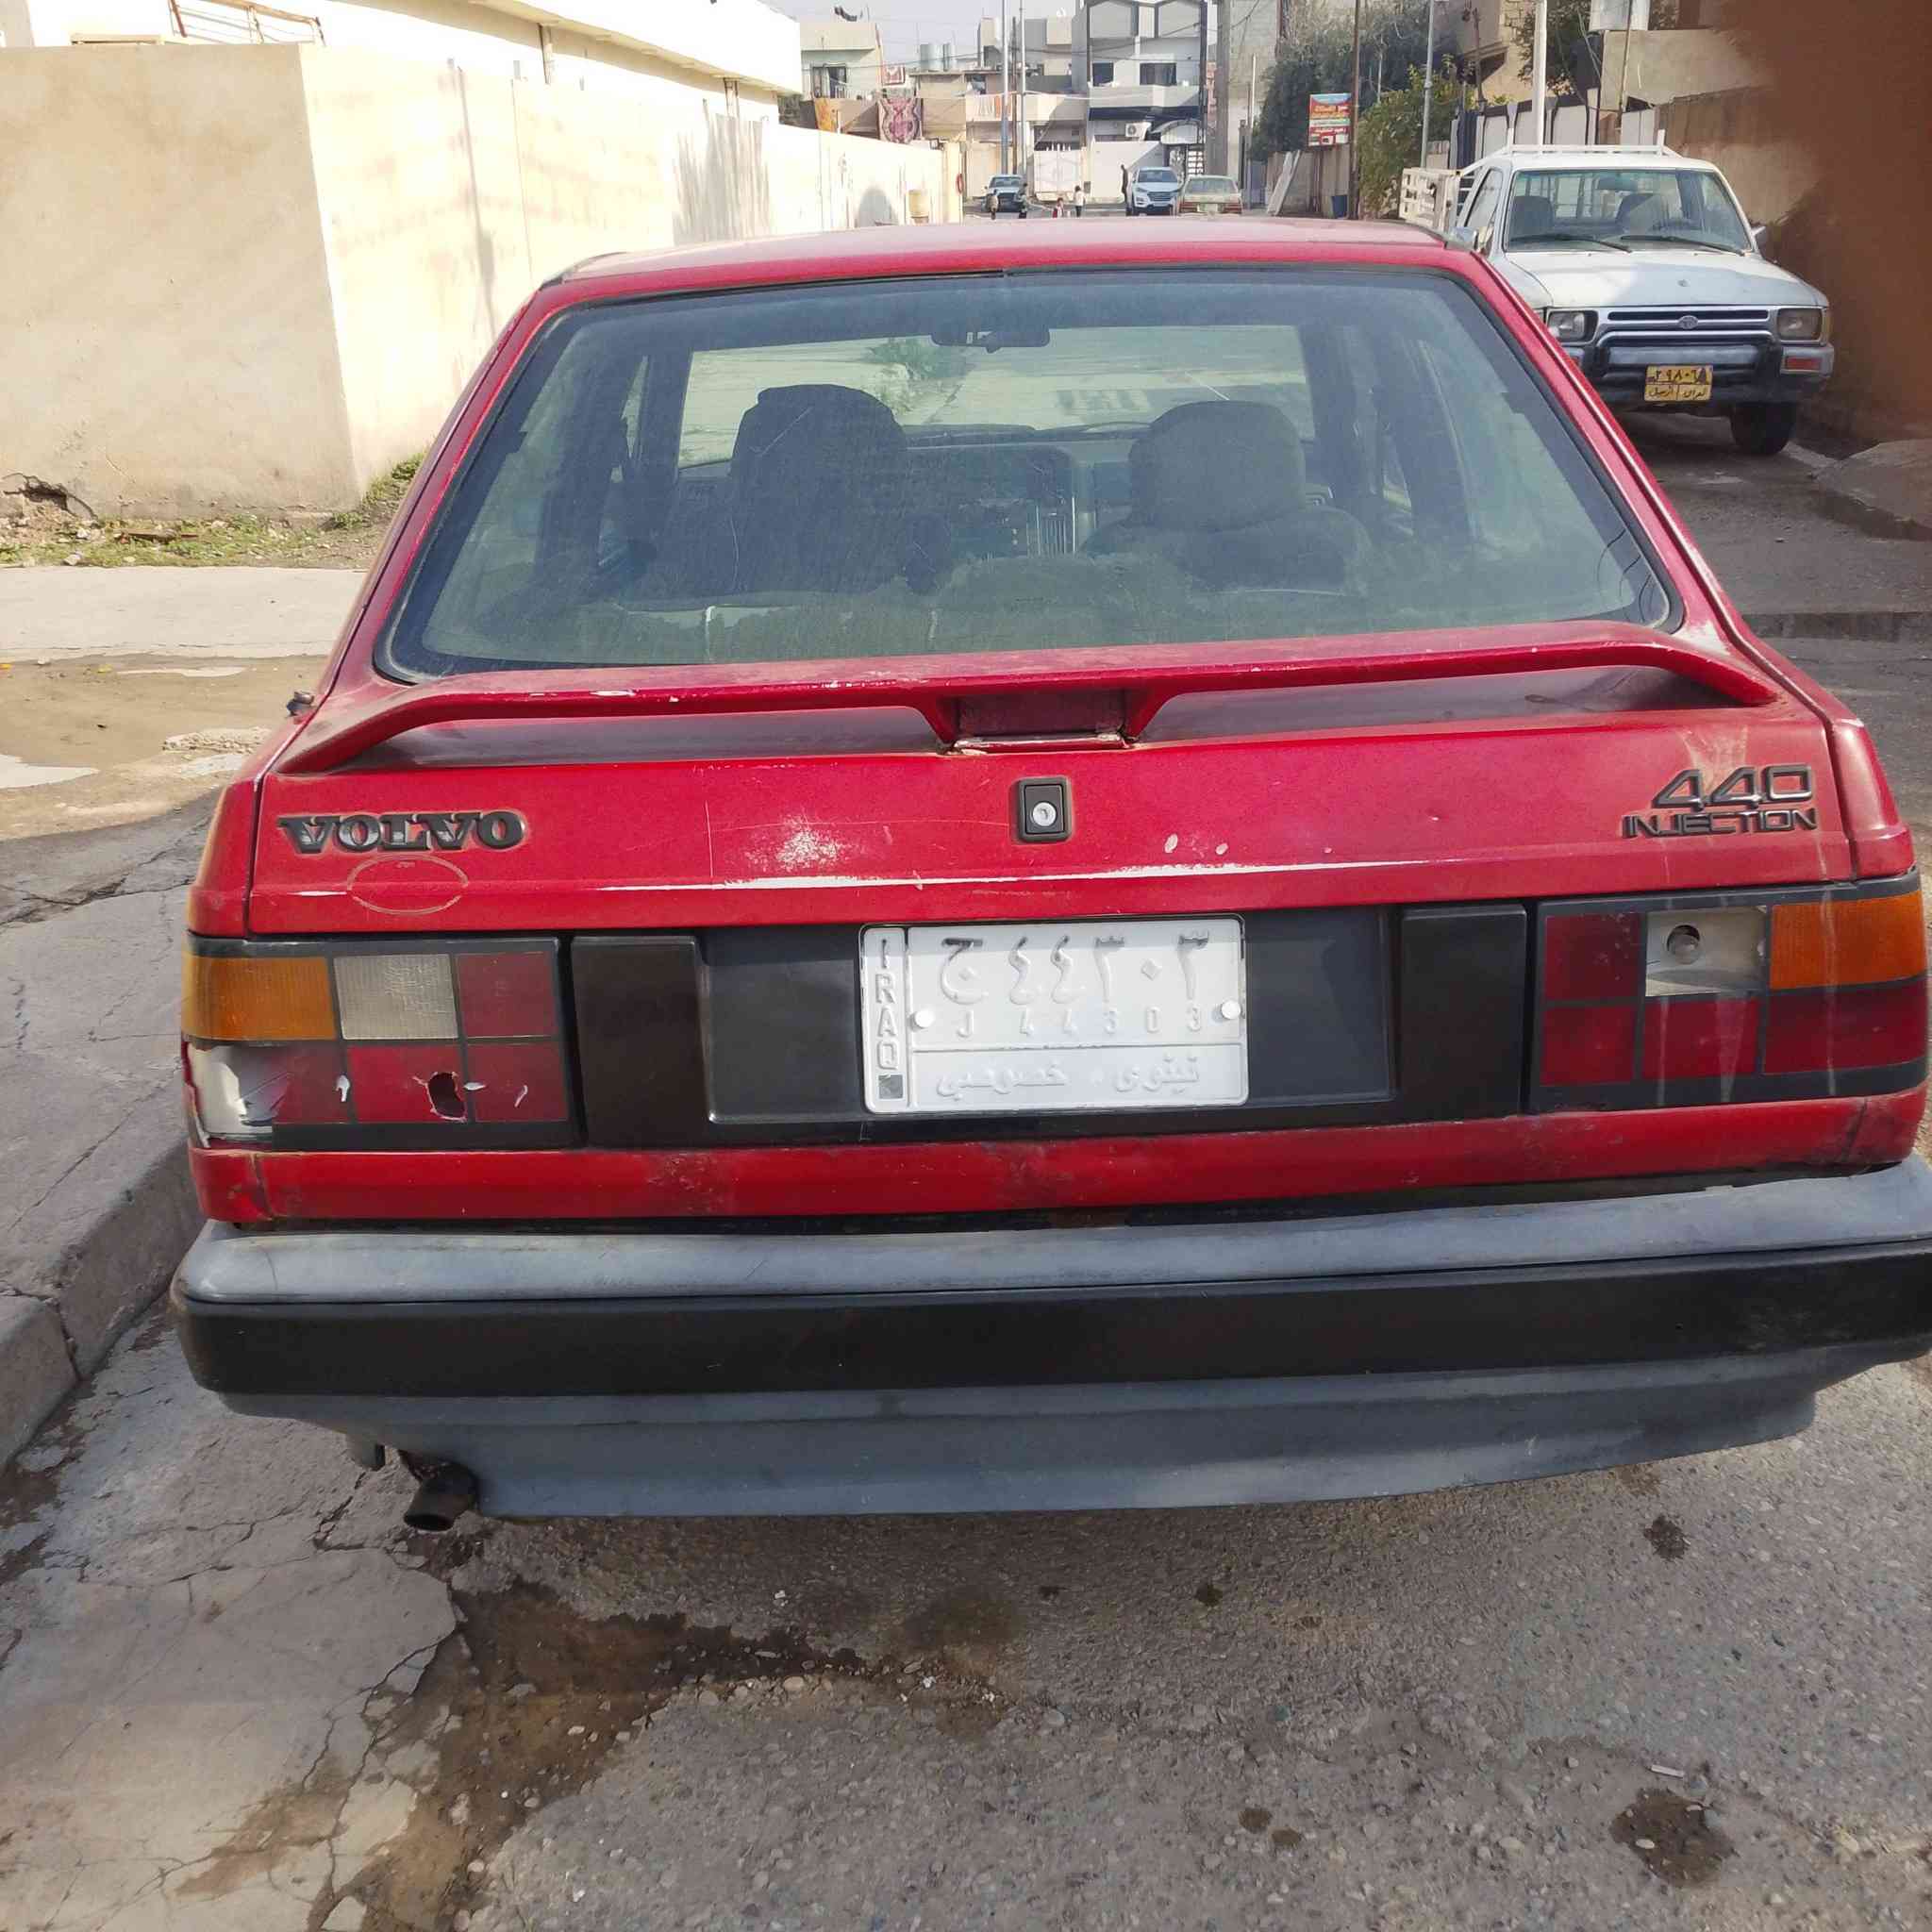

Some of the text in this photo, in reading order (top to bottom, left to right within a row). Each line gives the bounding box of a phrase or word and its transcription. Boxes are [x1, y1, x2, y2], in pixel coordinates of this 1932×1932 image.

[1652, 763, 1812, 811] 440
[277, 809, 526, 855] VOLVO
[1622, 808, 1817, 839] INJECTION
[874, 938, 899, 1070] IRAQ
